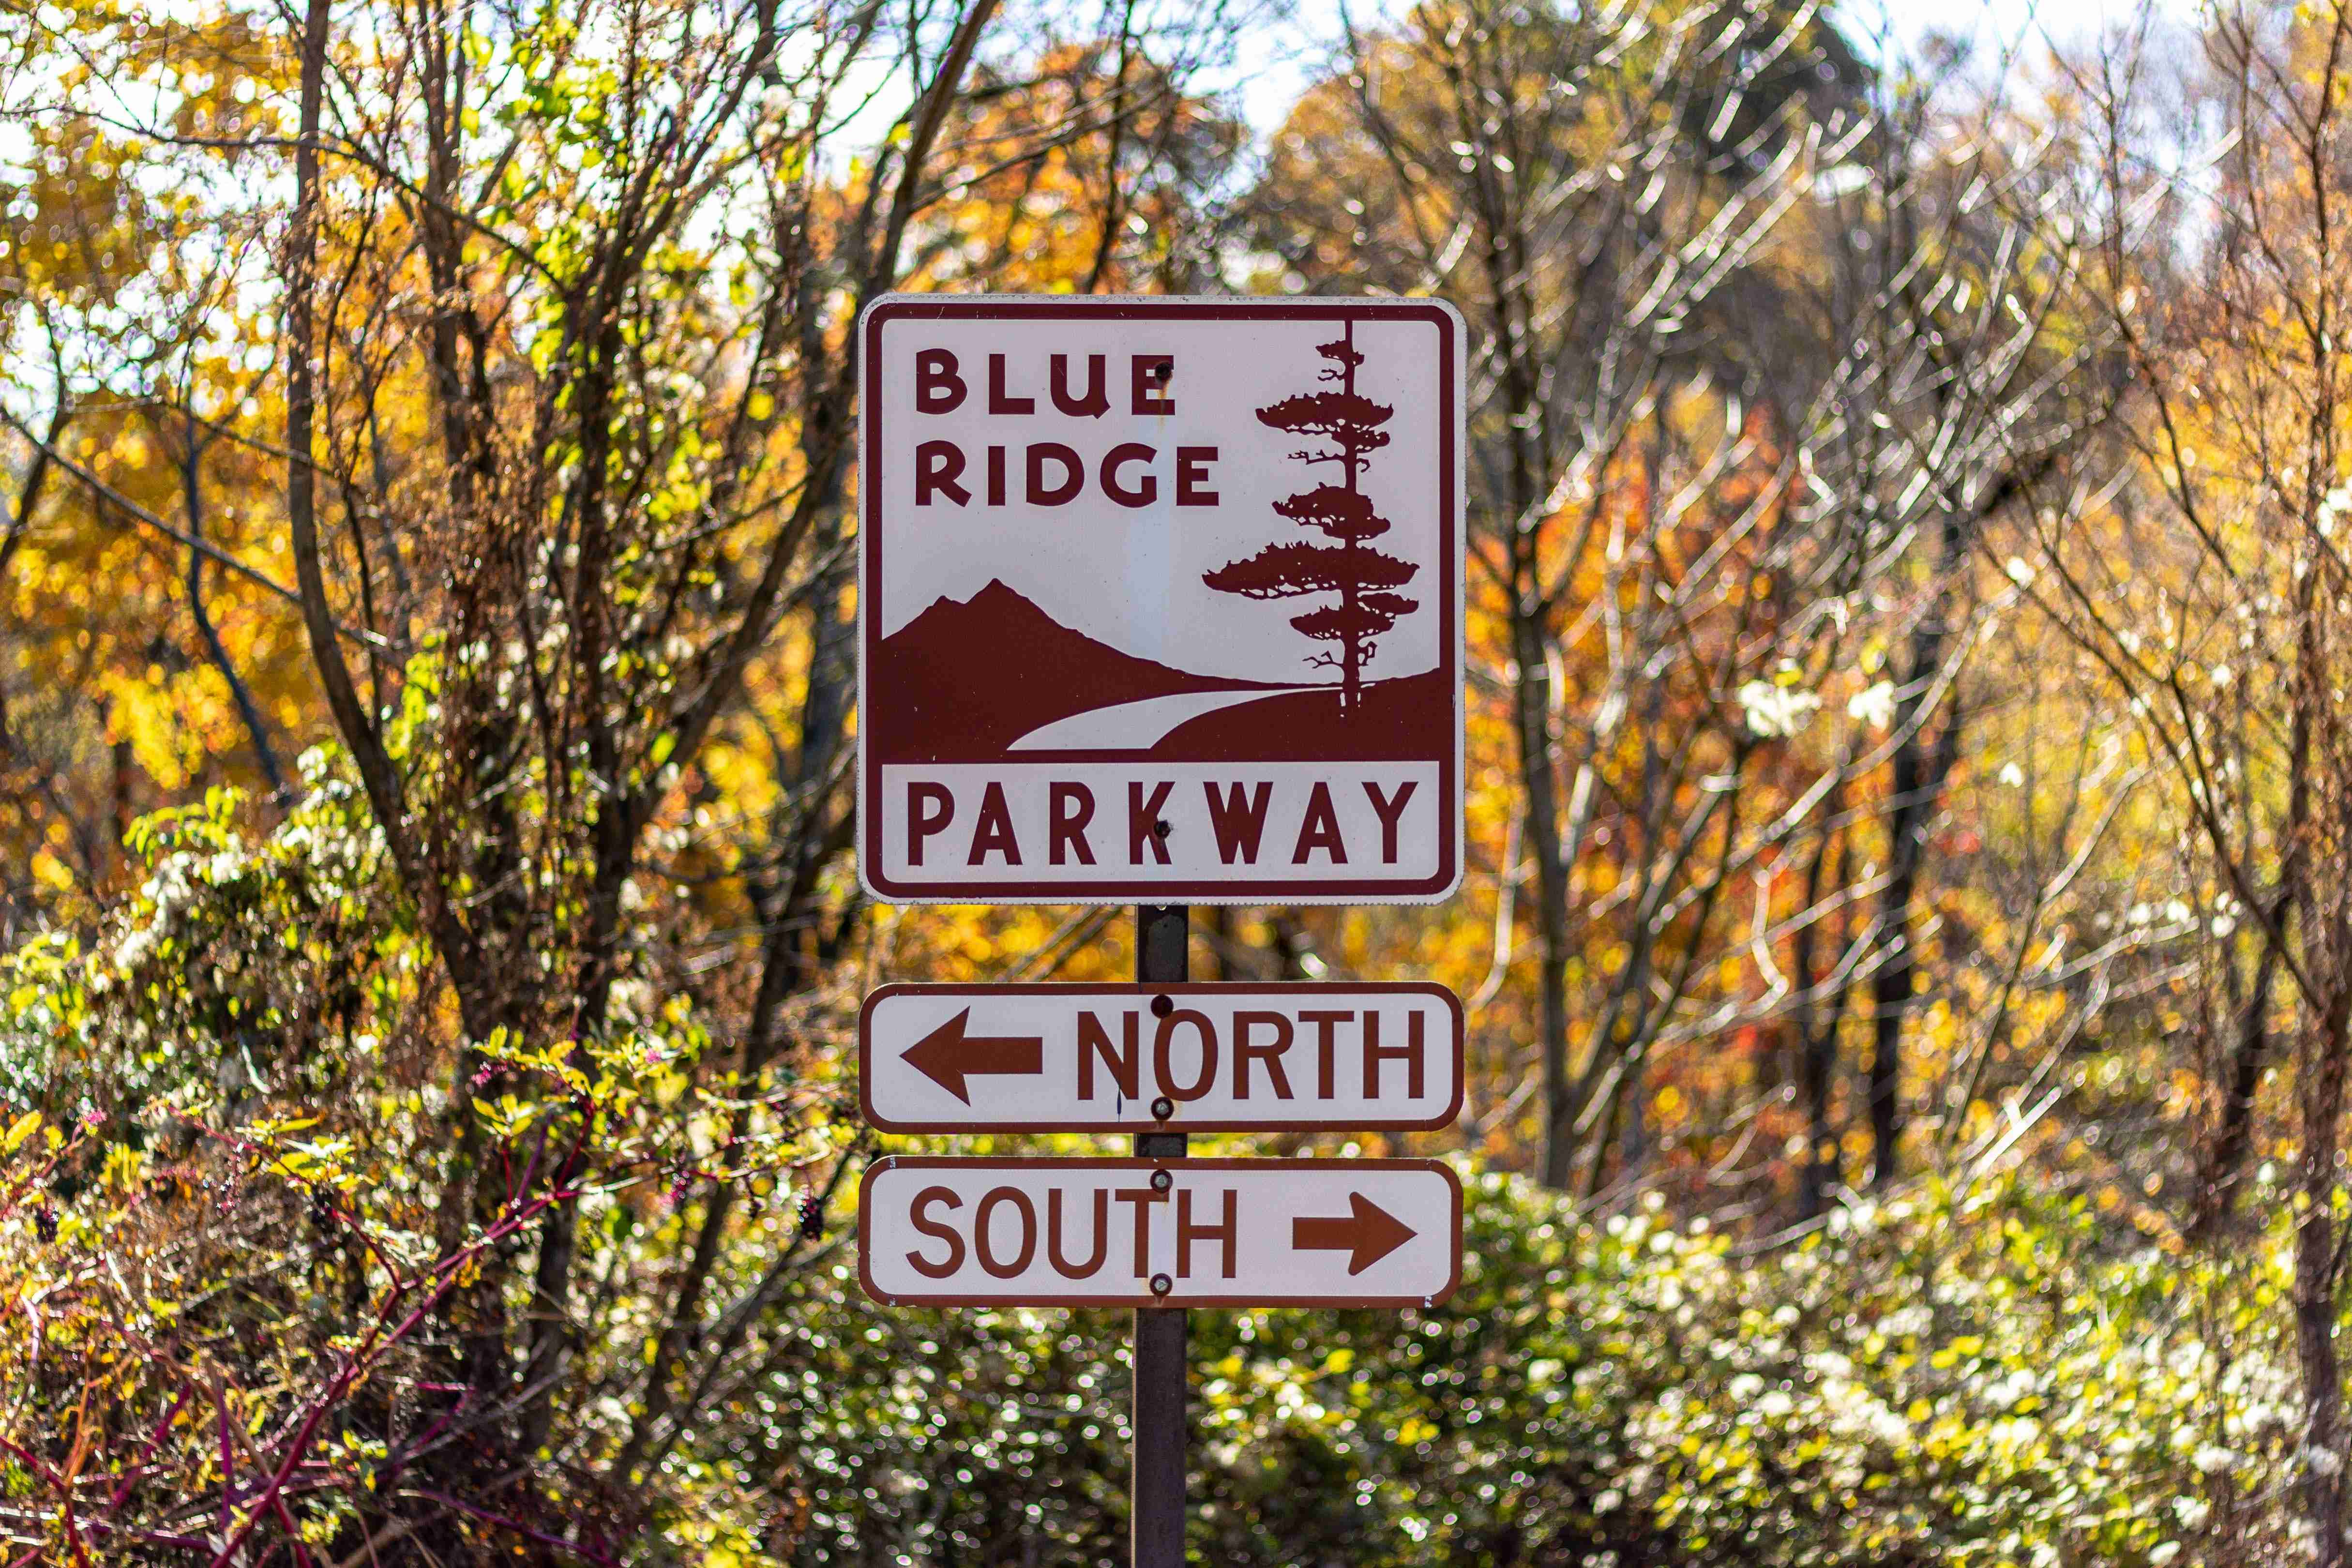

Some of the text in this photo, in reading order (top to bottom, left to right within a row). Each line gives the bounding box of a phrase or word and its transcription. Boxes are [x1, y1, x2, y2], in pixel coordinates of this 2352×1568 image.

[915, 348, 1176, 420] BLUE
[915, 440, 1220, 508] RIDGE
[907, 782, 1419, 867] PARKWAY
[1076, 1009, 1425, 1102] NORTH
[905, 1186, 1237, 1280] SOUTH
